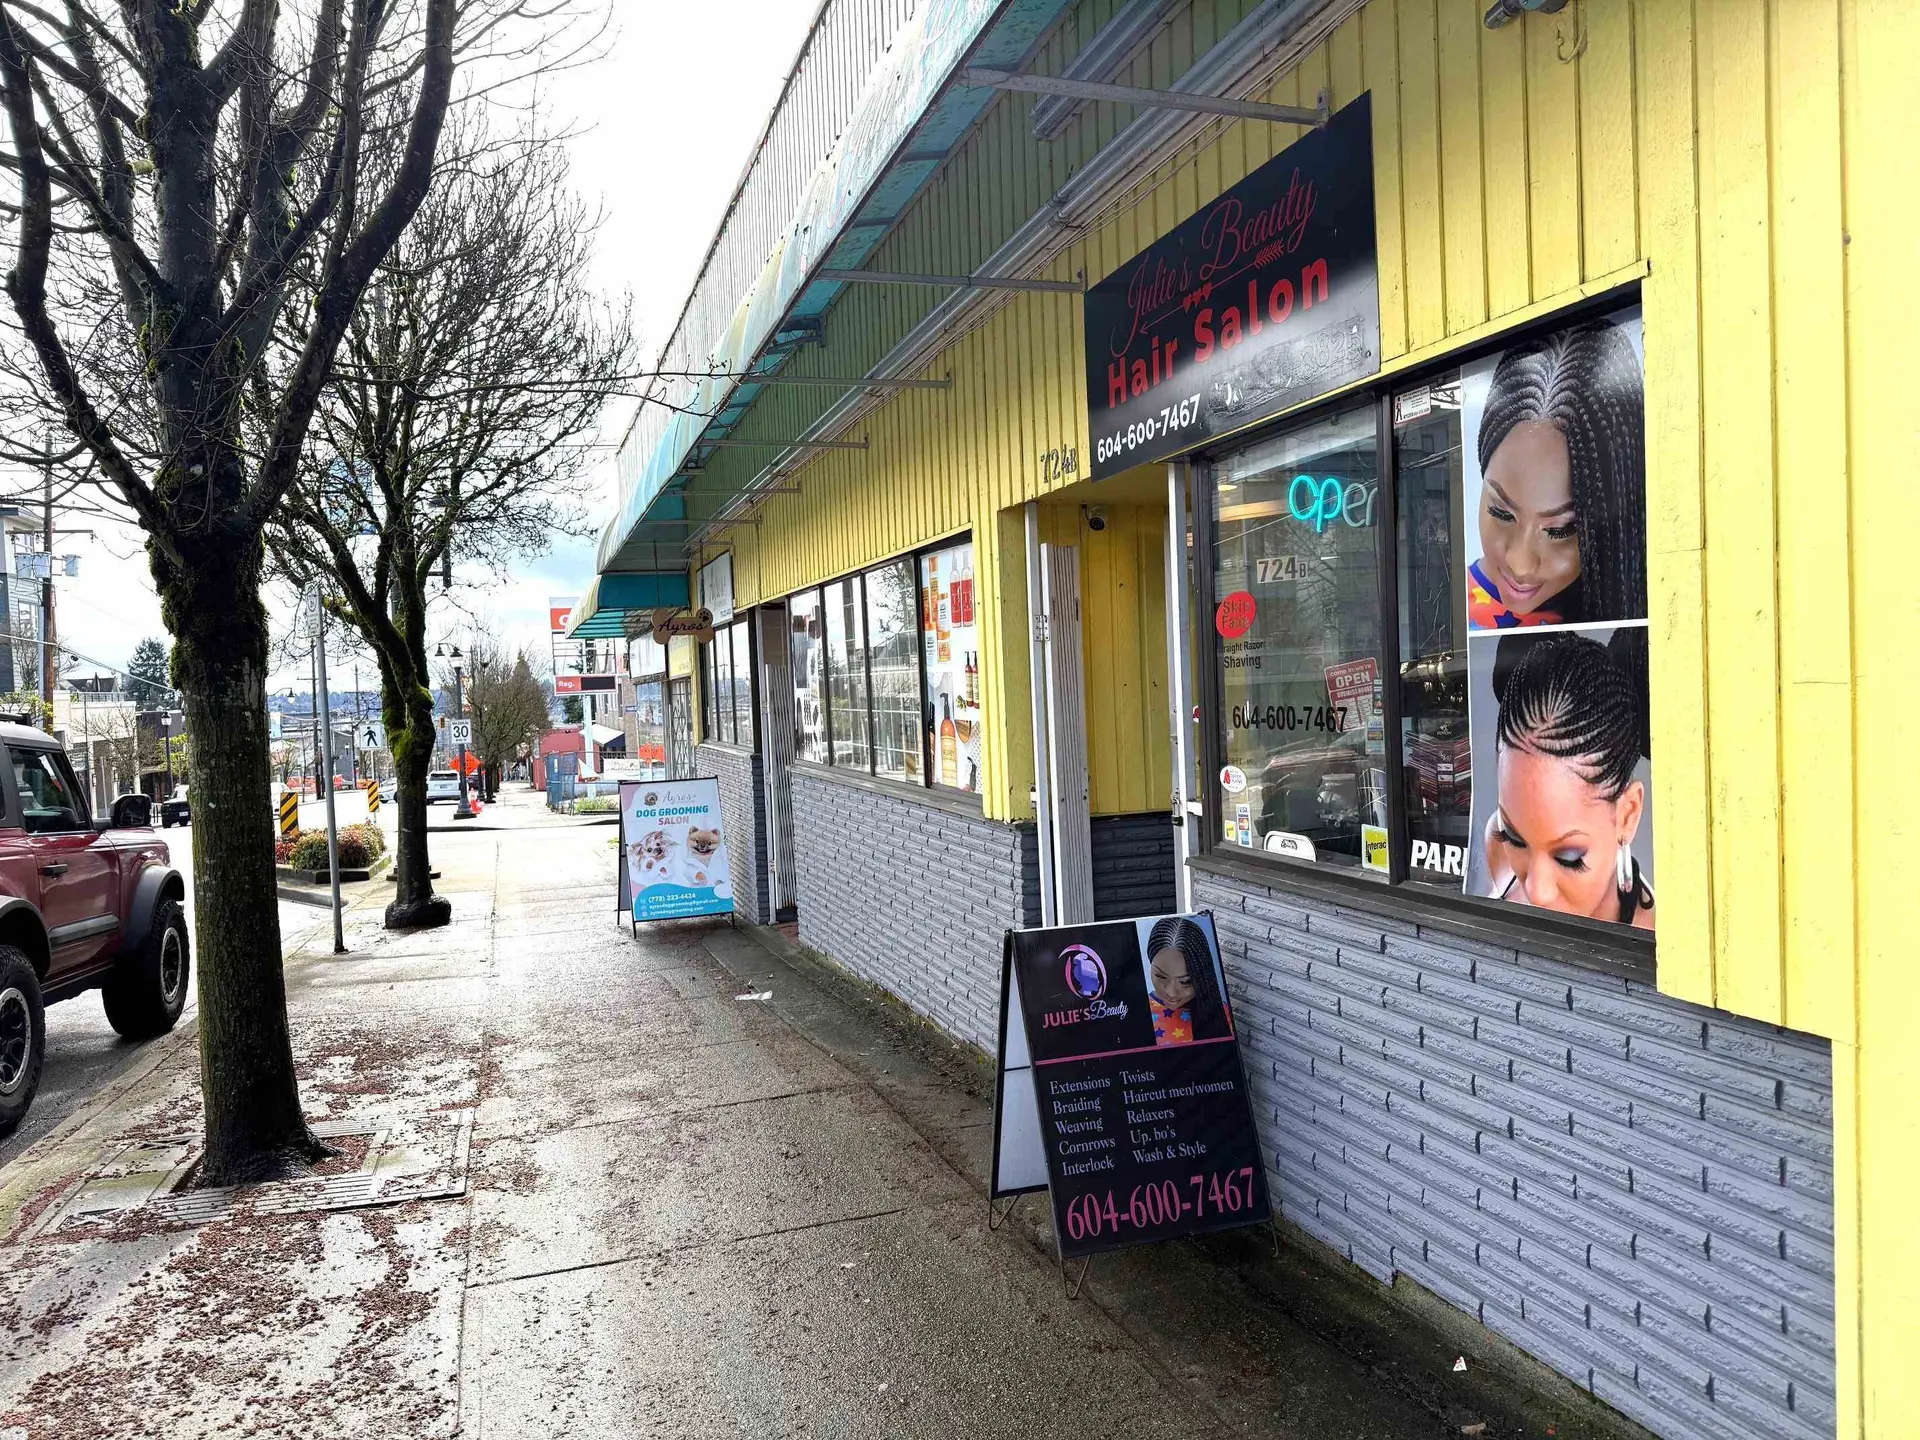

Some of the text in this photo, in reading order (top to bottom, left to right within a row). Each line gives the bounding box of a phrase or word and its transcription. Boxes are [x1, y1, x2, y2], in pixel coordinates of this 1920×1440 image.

[1110, 166, 1319, 357] Julie's Beauty
[1108, 334, 1177, 408] Hair
[1193, 257, 1329, 362] Salon
[1097, 392, 1201, 464] 604-600-7467
[1040, 443, 1077, 483] 724B
[1223, 599, 1251, 615] Skin
[659, 618, 703, 635] Ayros
[1223, 641, 1264, 654] raight Razor
[1223, 654, 1261, 669] Shaving
[1330, 669, 1347, 677] come
[1355, 664, 1372, 672] we're
[558, 680, 574, 688] Reg.
[1336, 671, 1370, 688] OPEN
[1232, 705, 1347, 732] 604-600-7467
[453, 725, 469, 738] 30
[662, 791, 692, 804] Ayros
[636, 805, 709, 818] DOG GROOMING
[658, 816, 689, 826] SALON
[1366, 840, 1387, 855] Interac
[1042, 999, 1129, 1029] JULIE'S Beauty
[1049, 1075, 1110, 1094] Extensions
[1119, 1069, 1155, 1084] Twists
[1123, 1078, 1234, 1105] Haircut men/women
[1052, 1098, 1101, 1116] Braiding
[1127, 1107, 1174, 1124] Relaxers
[1055, 1118, 1104, 1137] Weaving
[1059, 1135, 1116, 1156] Cornrows
[1133, 1142, 1207, 1165] Wash & Style
[1062, 1156, 1114, 1176] Interlock
[1067, 1166, 1254, 1240] 604-600-7467
